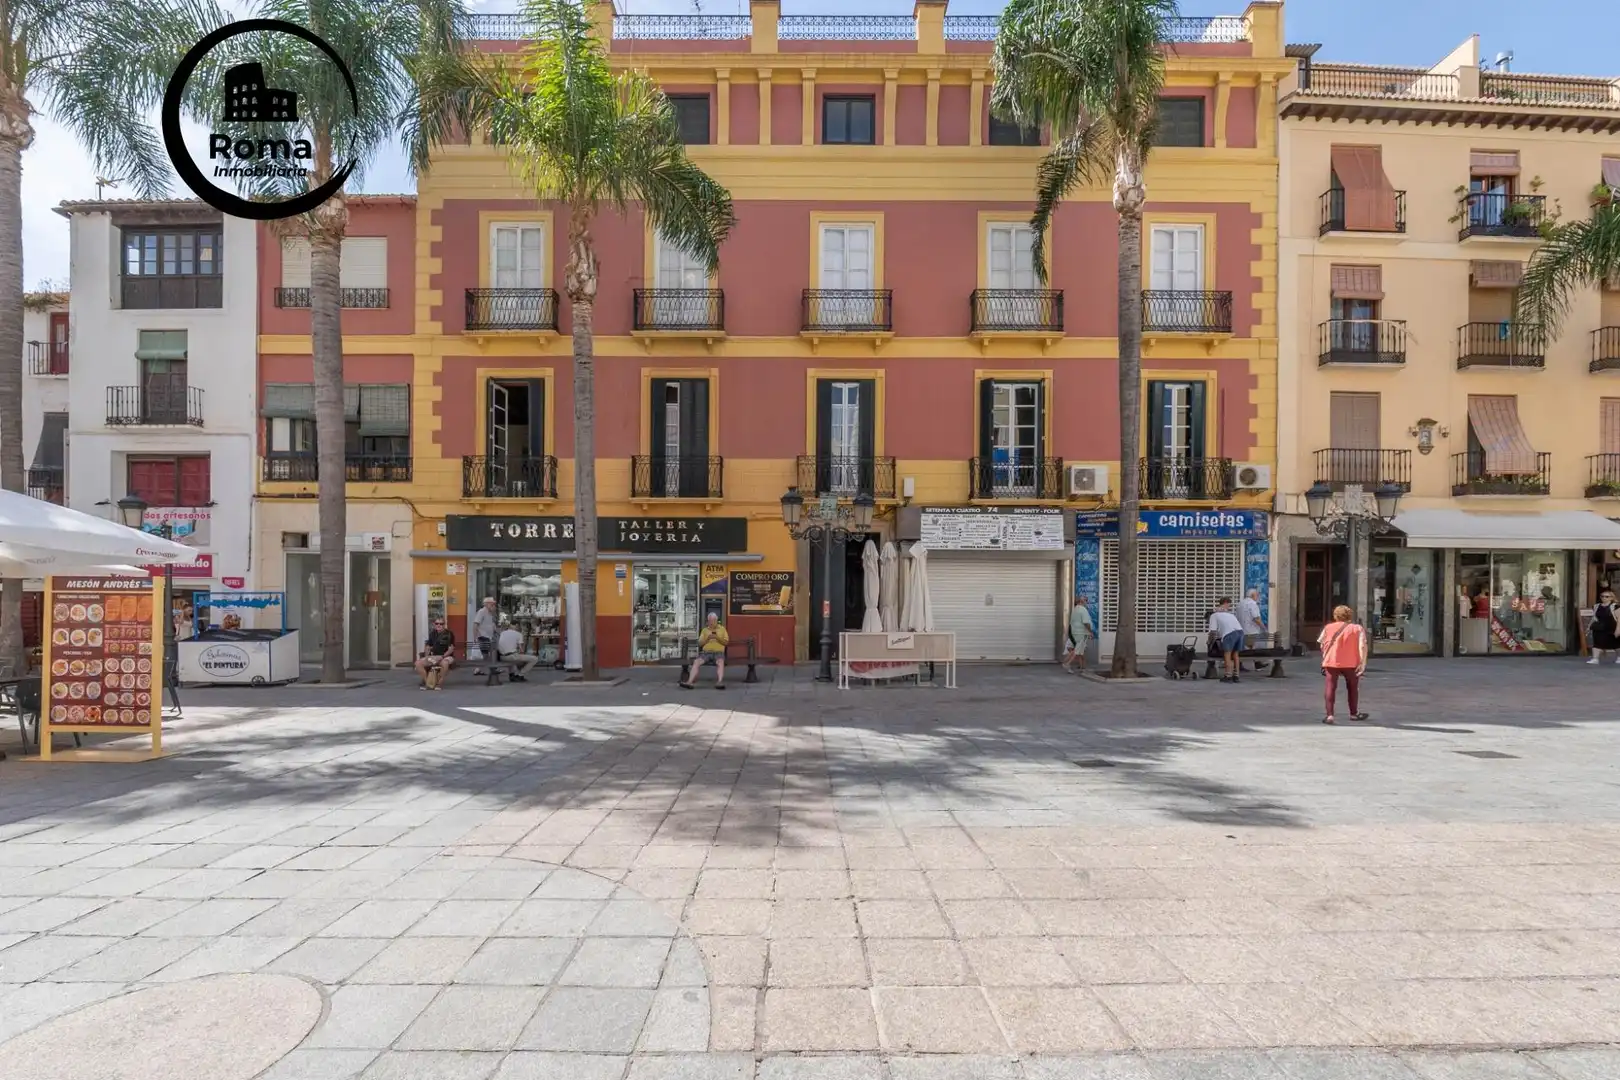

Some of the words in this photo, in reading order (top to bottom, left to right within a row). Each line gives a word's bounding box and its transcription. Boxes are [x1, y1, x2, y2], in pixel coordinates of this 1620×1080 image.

[163, 512, 211, 520] artesanos
[1159, 511, 1245, 528] camisetas
[618, 520, 688, 530] TALLER
[697, 522, 705, 530] Y
[620, 531, 702, 543] JOYERIA
[705, 564, 724, 573] ATM
[735, 573, 770, 581] COMPRO
[771, 573, 789, 581] ORO
[66, 579, 100, 589] MESÓN
[103, 579, 141, 589] ANDRÉS
